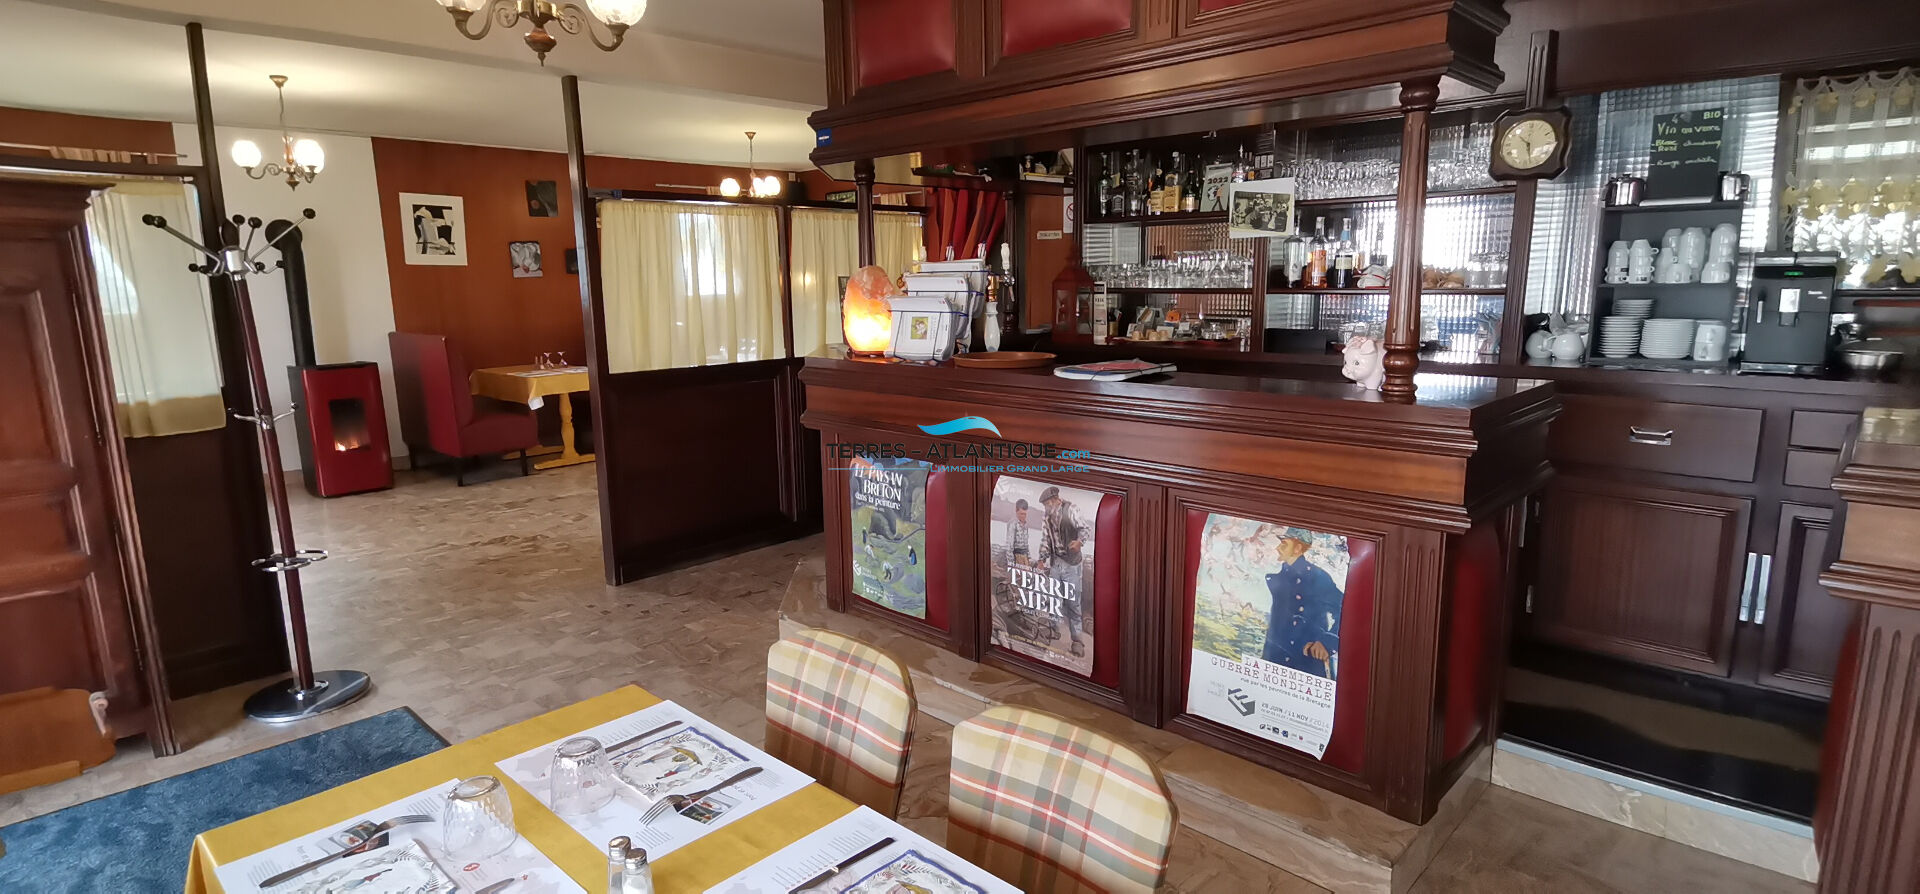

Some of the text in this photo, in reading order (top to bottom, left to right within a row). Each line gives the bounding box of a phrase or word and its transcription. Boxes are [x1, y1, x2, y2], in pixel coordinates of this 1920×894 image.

[1703, 110, 1721, 119] BIO
[1657, 122, 1677, 136] Vin
[1207, 176, 1229, 184] 2022
[868, 465, 903, 488] PAYSAN
[863, 479, 902, 502] BRETON
[1007, 566, 1076, 602] TERRE
[1016, 587, 1064, 618] MER
[1211, 656, 1332, 702] GUERRE MONDIALE
[1245, 656, 1333, 691] LA PREMIERE
